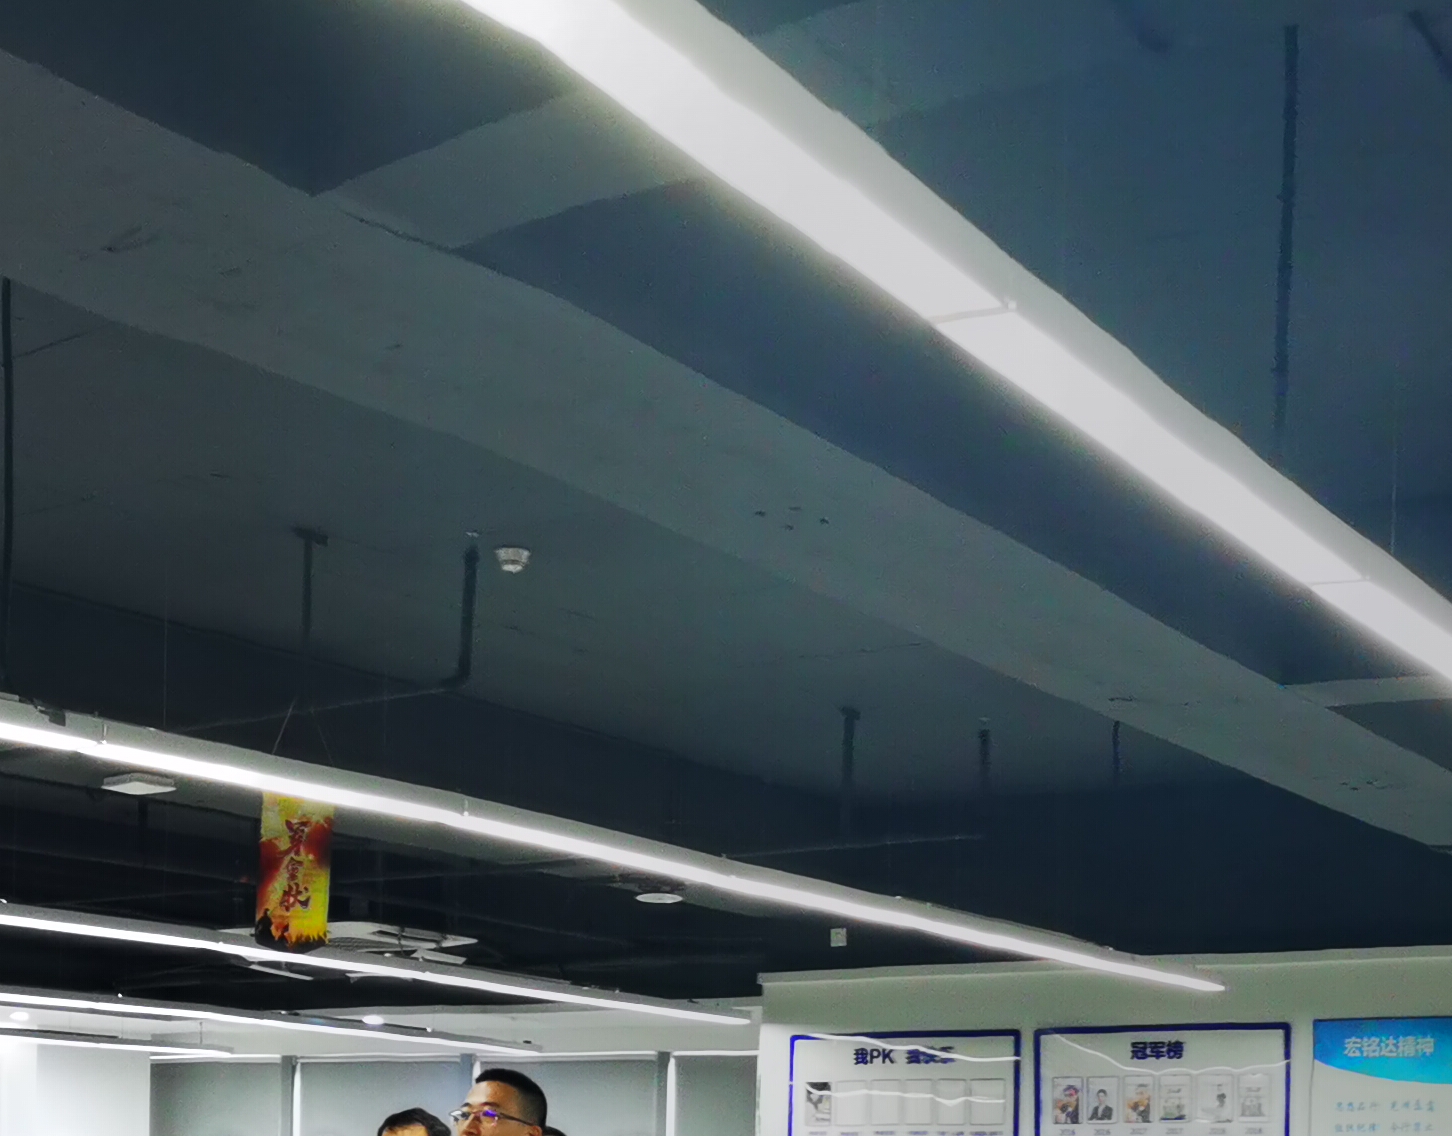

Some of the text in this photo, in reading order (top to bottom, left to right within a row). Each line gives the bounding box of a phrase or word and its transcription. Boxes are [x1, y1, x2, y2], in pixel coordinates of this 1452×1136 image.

[1130, 1041, 1185, 1060] 冠军榜
[1344, 1036, 1435, 1057] 宏铭达精神
